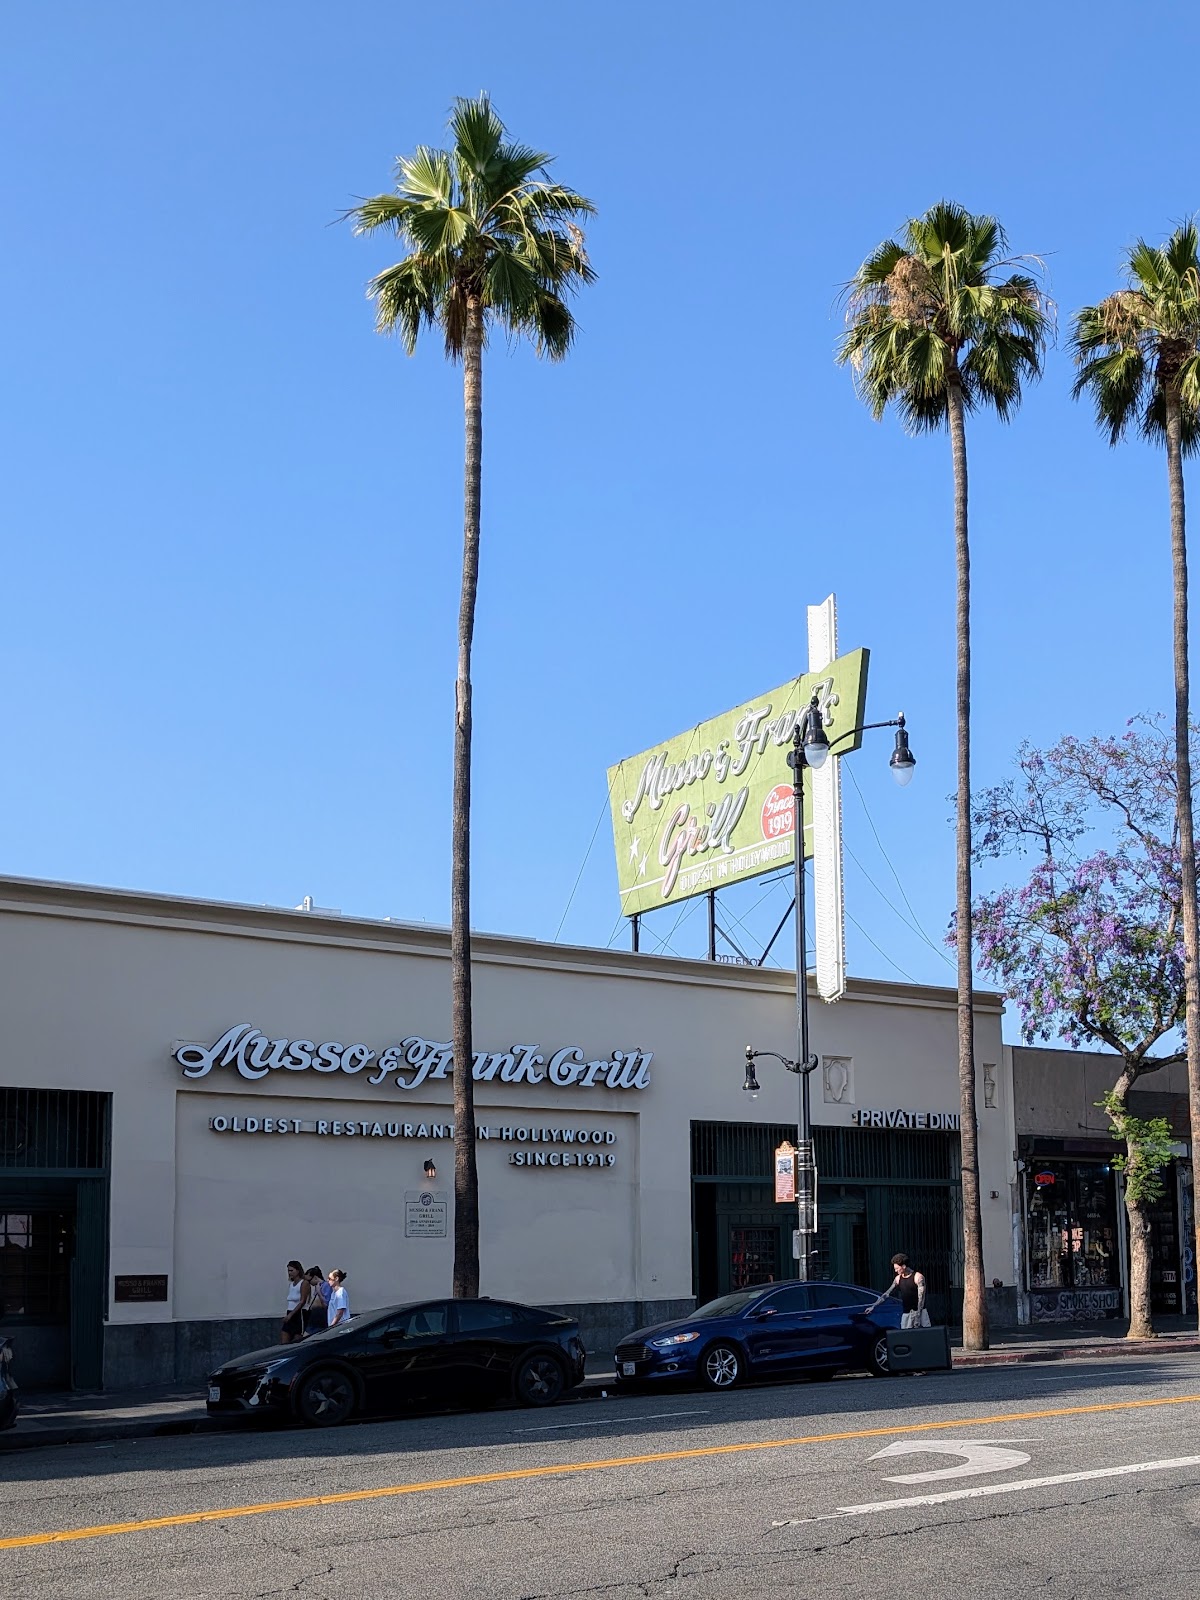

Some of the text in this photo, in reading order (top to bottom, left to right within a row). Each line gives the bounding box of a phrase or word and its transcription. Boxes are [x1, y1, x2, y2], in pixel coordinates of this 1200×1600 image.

[622, 751, 714, 824] Musso
[714, 739, 731, 783] &
[764, 791, 795, 817] Since
[768, 811, 793, 836] 1919
[658, 786, 749, 898] Grill
[730, 839, 791, 875] HOLLYWOOD
[174, 1023, 376, 1080] Musso
[367, 1046, 402, 1085] &
[547, 1045, 654, 1090] Grill
[212, 1116, 302, 1134] OLDEST
[315, 1119, 455, 1139] RESTAURANT
[501, 1126, 616, 1145] HOLLYWOOD
[858, 1109, 979, 1131] PRIVATE DINI
[513, 1151, 616, 1168] SINCE 1919
[1035, 1174, 1055, 1185] OPEN
[1161, 1272, 1177, 1281] ATM
[1059, 1292, 1118, 1310] SMOKE SHOP
